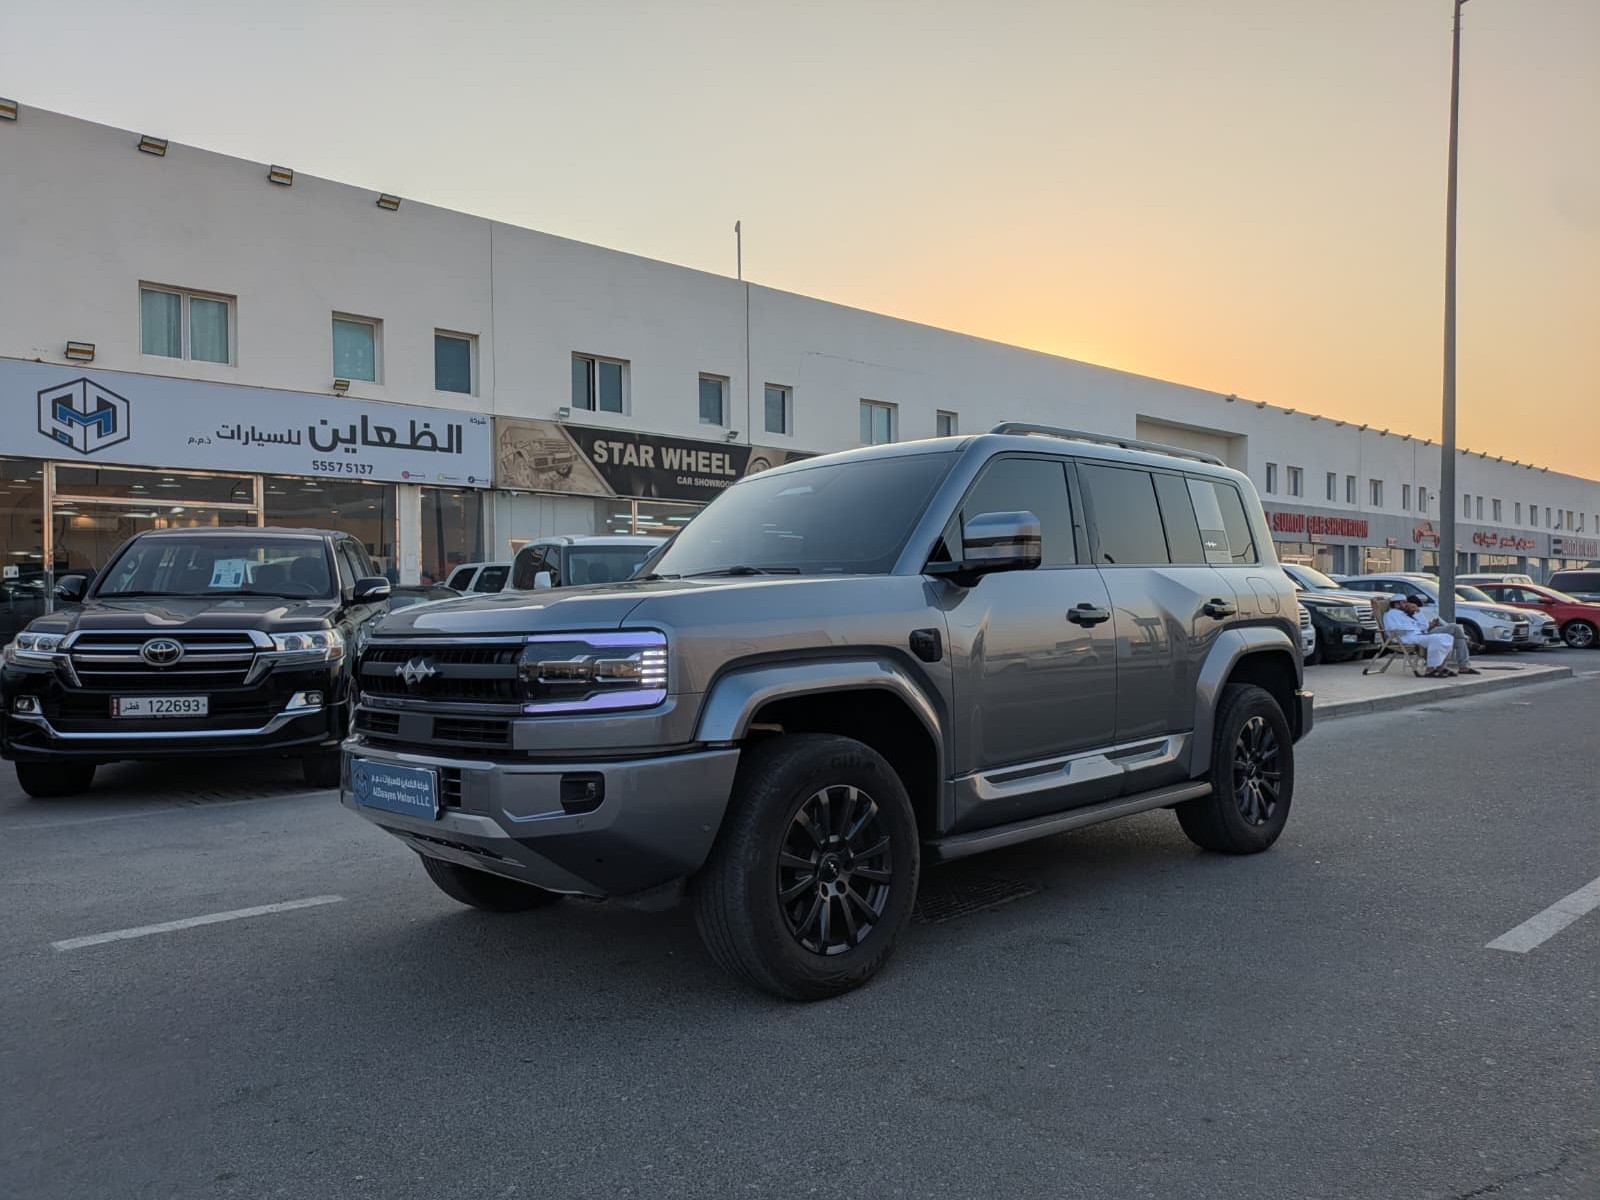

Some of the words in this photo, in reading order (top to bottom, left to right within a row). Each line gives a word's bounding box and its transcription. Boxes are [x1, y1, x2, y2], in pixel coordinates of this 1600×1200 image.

[216, 424, 301, 447] للسيارات
[308, 414, 462, 454] الظعاين
[312, 460, 343, 473] 5557
[345, 463, 374, 475] 5137
[593, 440, 655, 468] STAR
[661, 446, 736, 476] WHEEL
[676, 476, 693, 486] CAR
[148, 700, 200, 713] 122693
